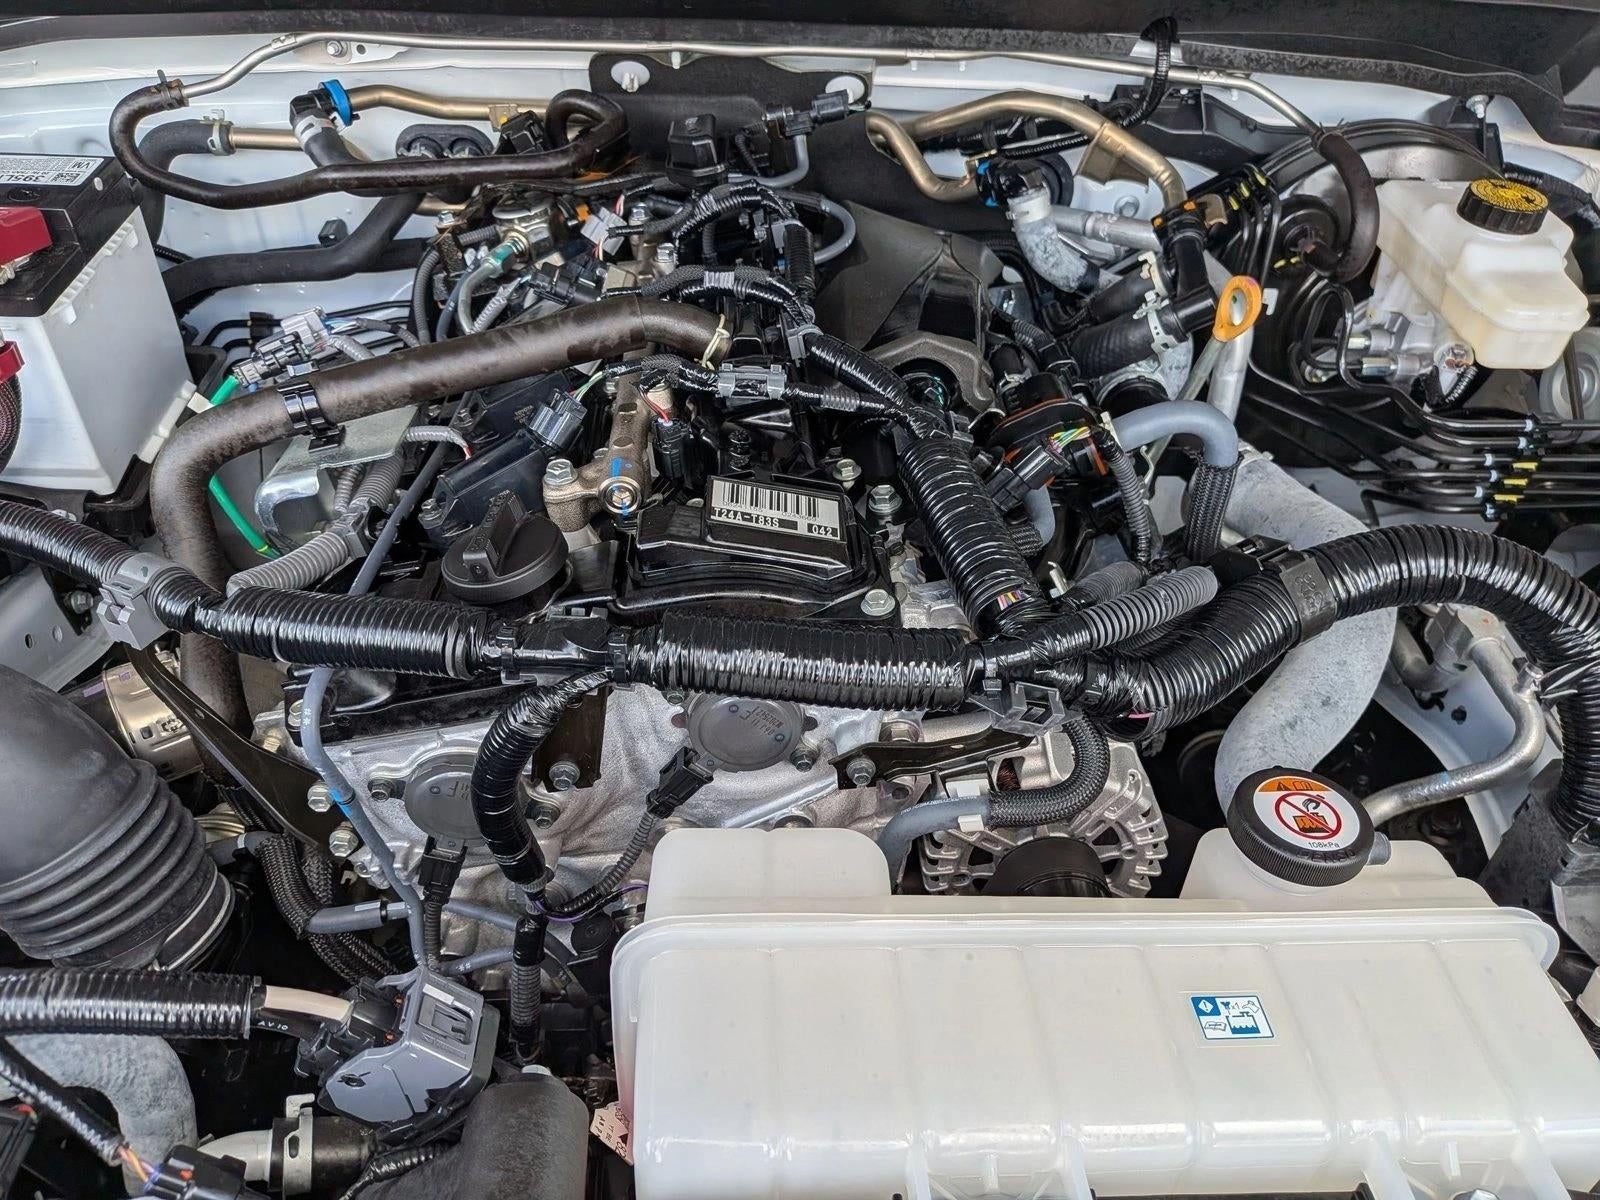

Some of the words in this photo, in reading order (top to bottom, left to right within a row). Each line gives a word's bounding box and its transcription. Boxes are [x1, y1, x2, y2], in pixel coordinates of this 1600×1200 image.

[71, 161, 91, 169] VM
[713, 507, 780, 529] T24A-T83S
[811, 525, 834, 538] 042
[1308, 841, 1340, 849] 108kPa
